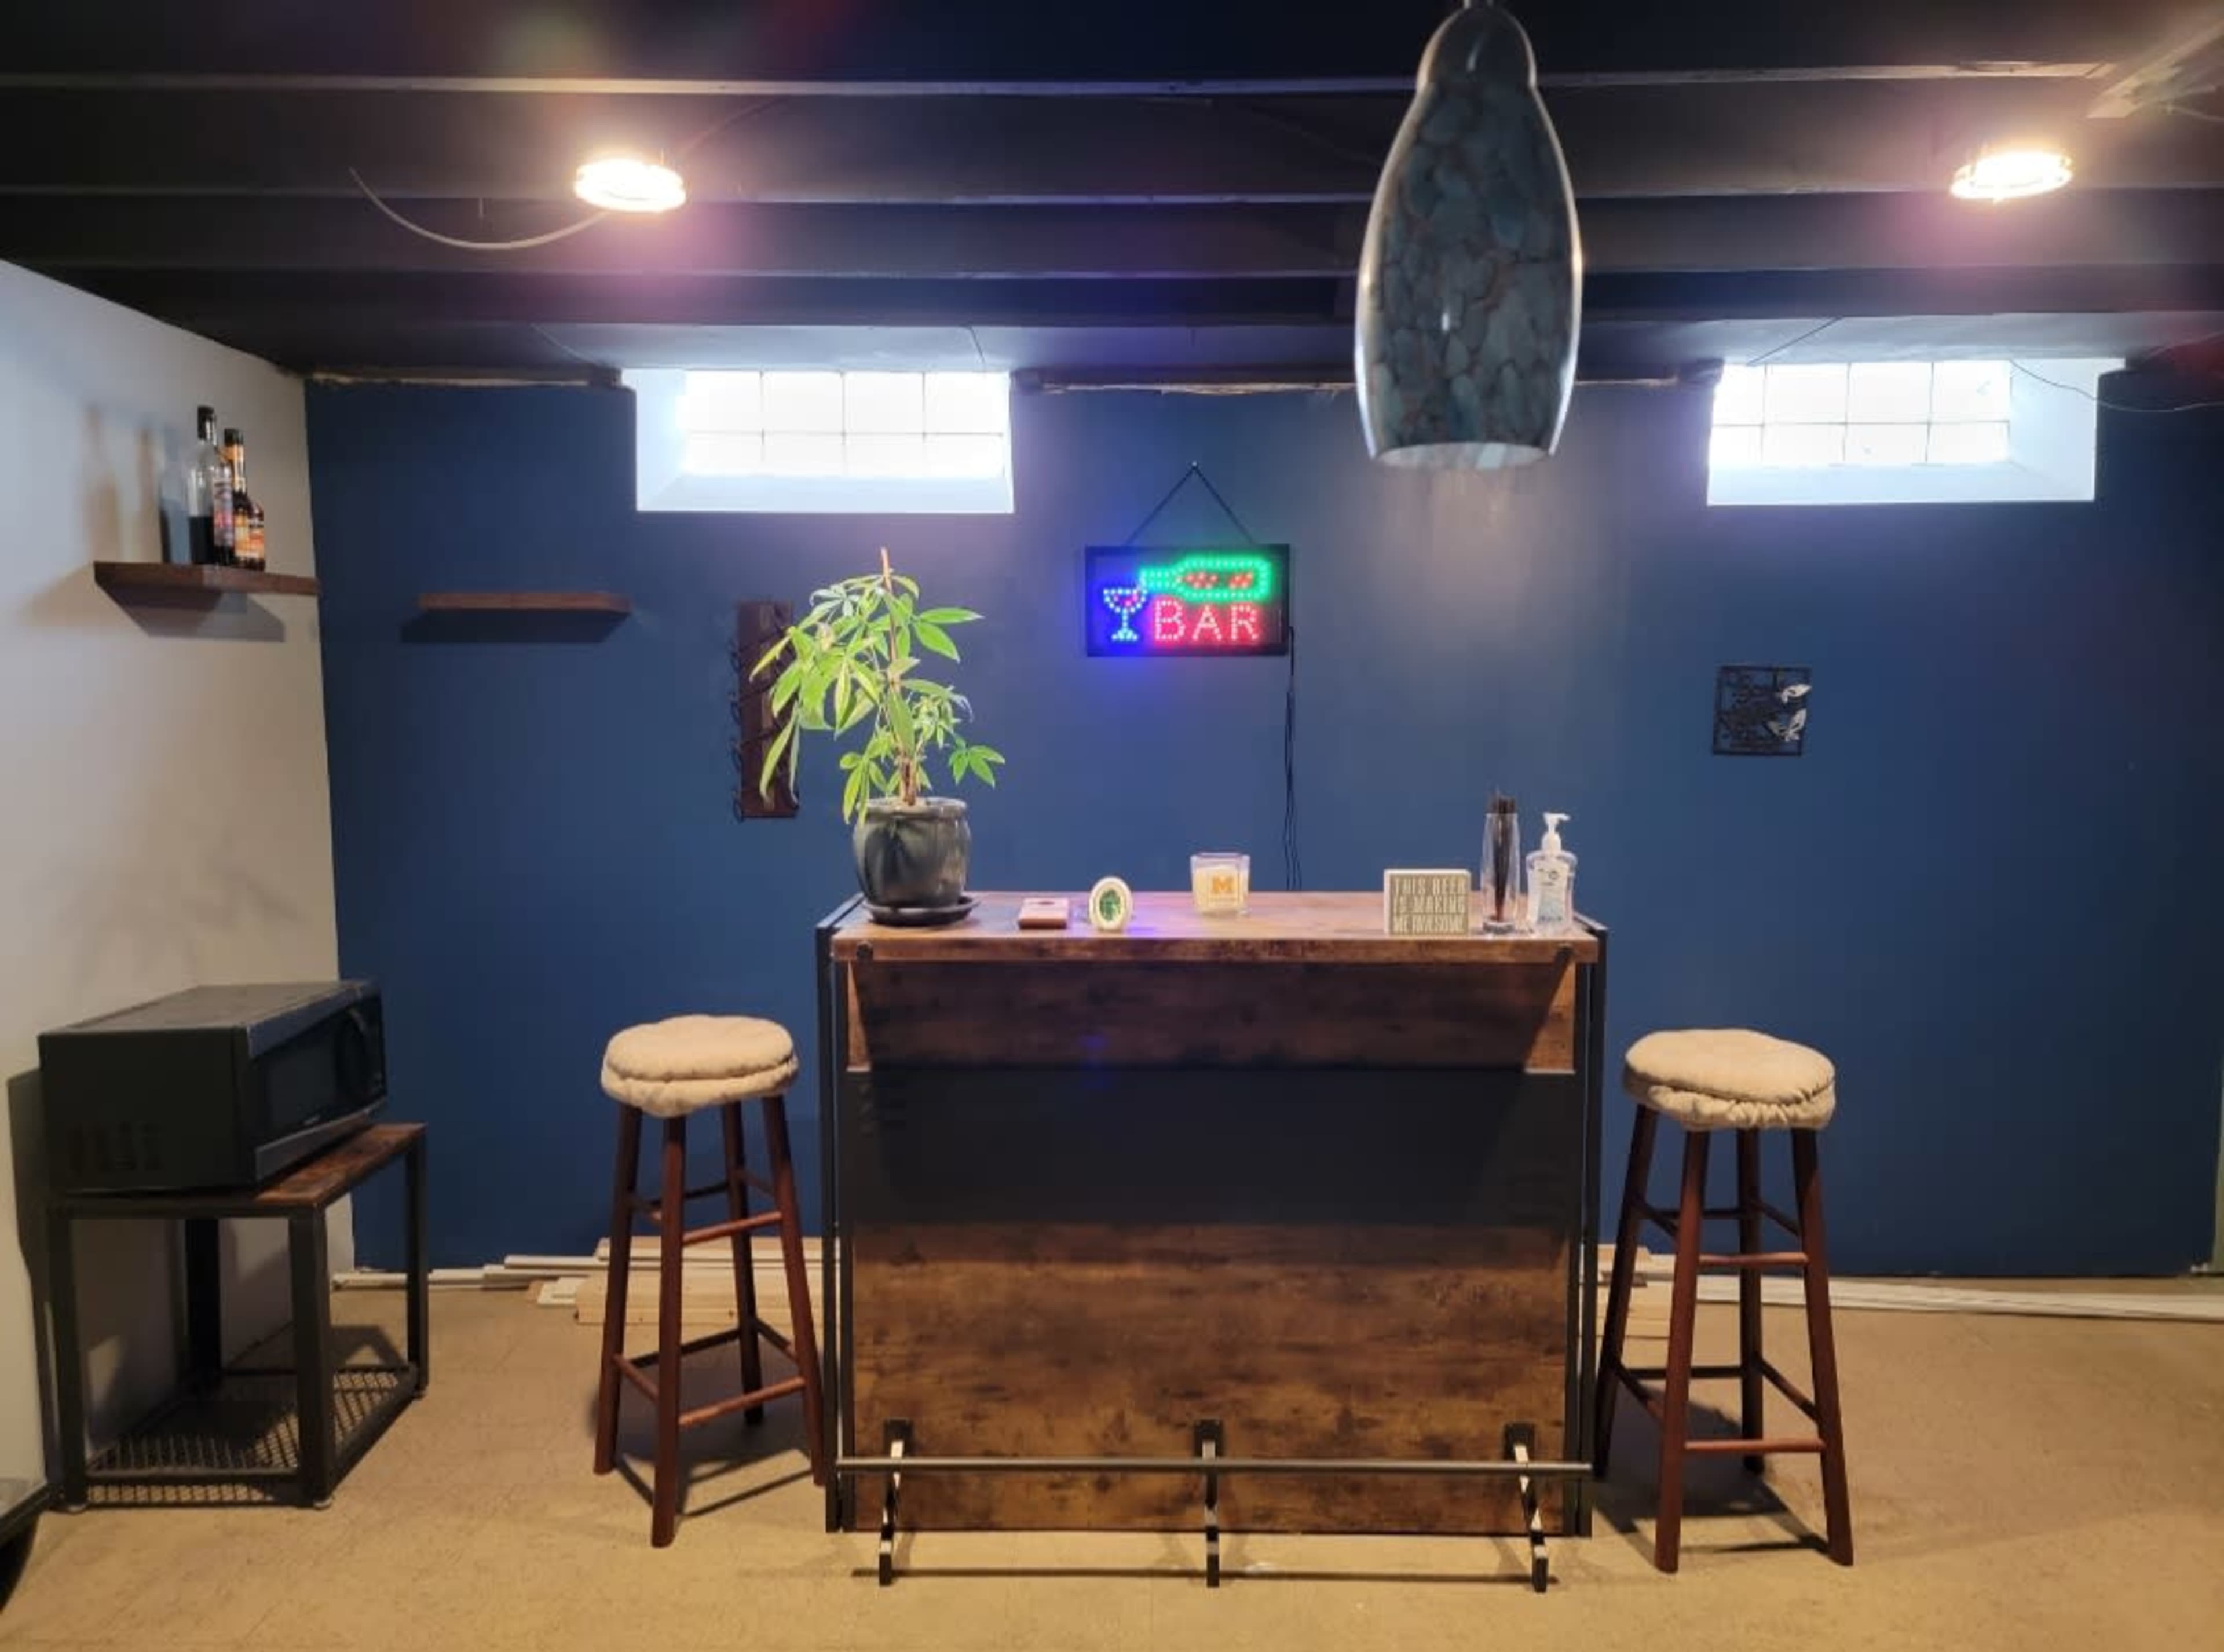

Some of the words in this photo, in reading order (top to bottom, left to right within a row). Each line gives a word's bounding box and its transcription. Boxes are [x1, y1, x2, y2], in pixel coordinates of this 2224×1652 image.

[1154, 598, 1260, 642] BAR
[1212, 875, 1234, 894] M
[1394, 877, 1426, 895] THIS
[1411, 896, 1465, 913] MAKING
